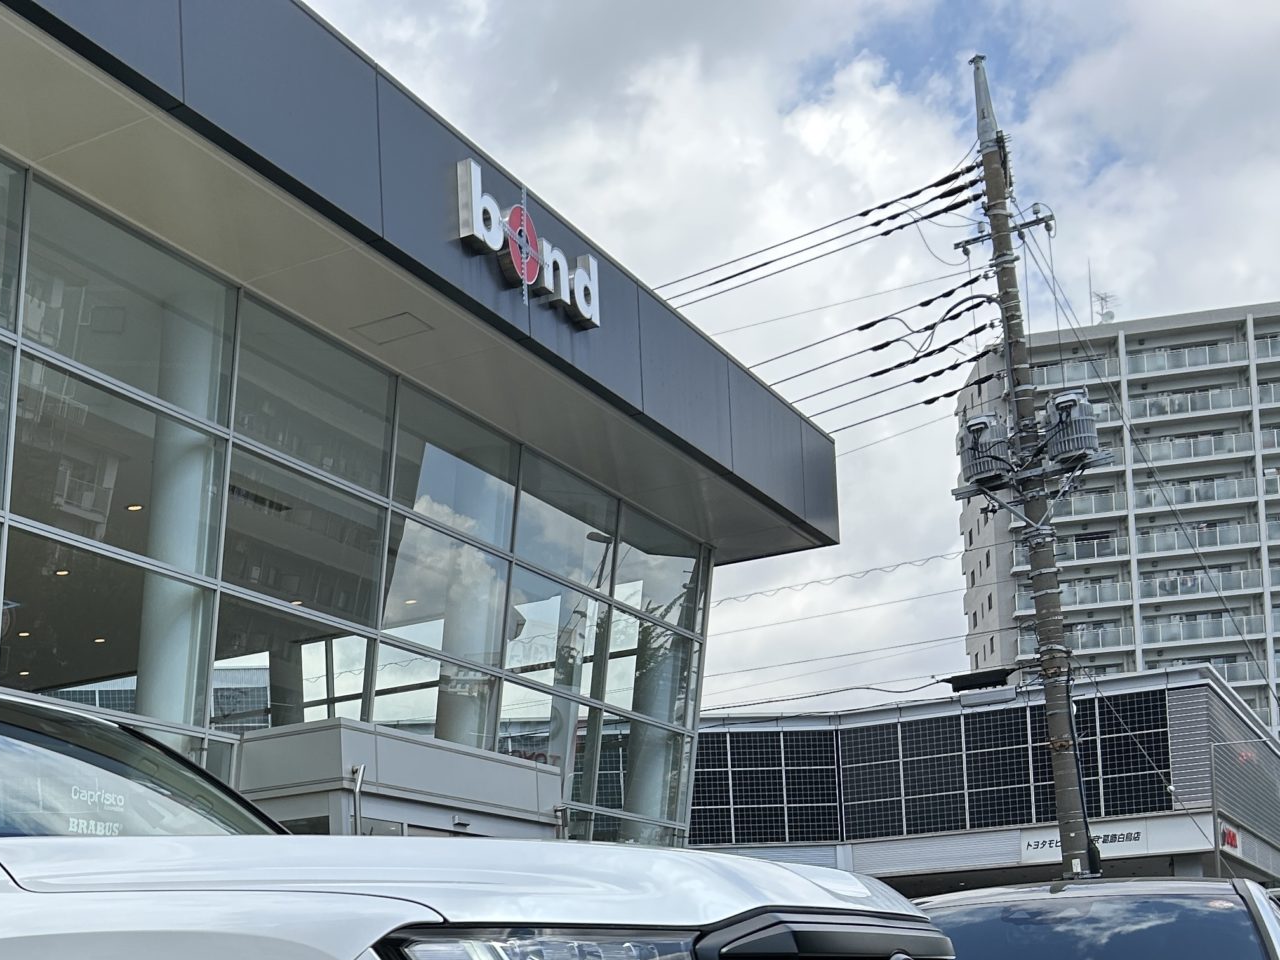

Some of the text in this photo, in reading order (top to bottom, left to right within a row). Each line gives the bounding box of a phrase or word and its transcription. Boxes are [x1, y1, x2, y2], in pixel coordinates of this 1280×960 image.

[457, 158, 600, 328] bond
[71, 785, 125, 806] Capristo
[68, 816, 120, 836] BRABUS
